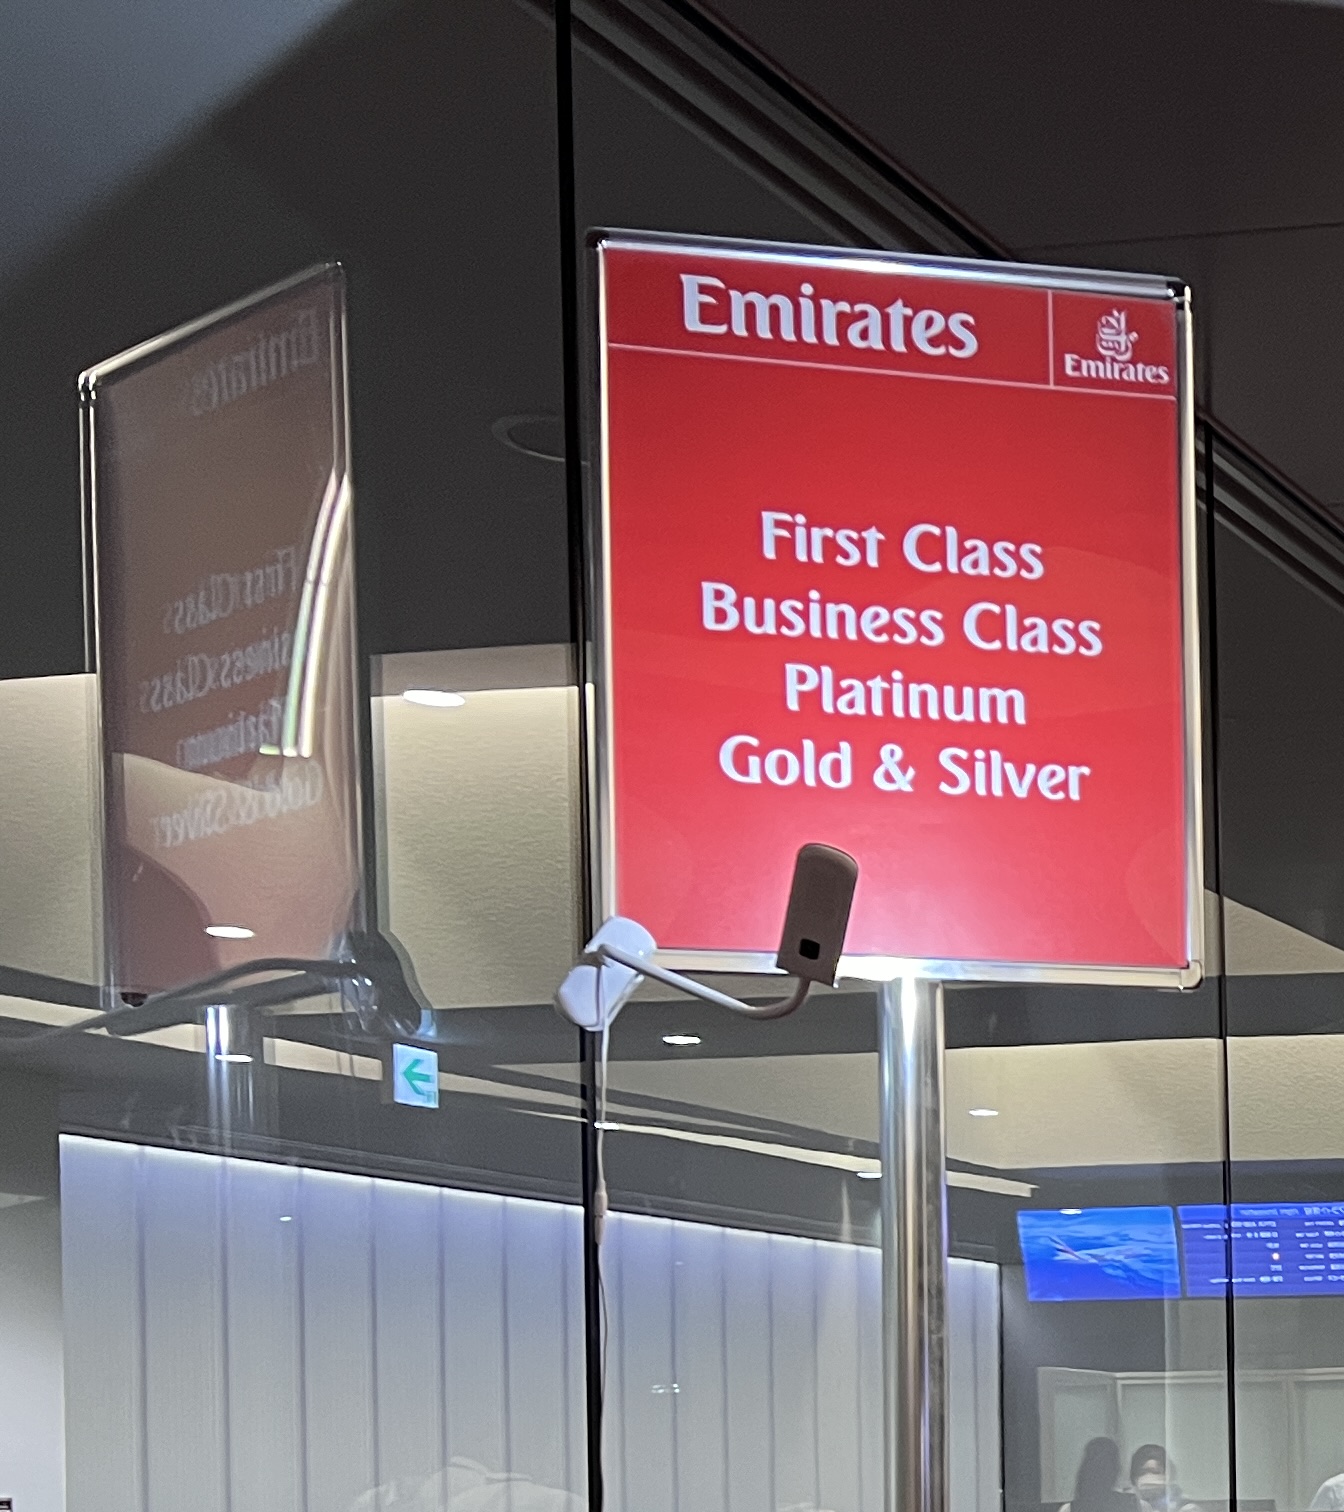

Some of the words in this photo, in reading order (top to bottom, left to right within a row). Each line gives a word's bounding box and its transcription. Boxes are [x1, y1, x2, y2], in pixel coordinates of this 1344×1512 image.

[679, 273, 979, 358] Emirates
[1064, 353, 1169, 384] Emirates
[761, 511, 885, 568] First
[902, 523, 1045, 580] Class
[701, 582, 943, 647] Business
[963, 603, 1103, 656] Class
[785, 663, 1026, 724] Platinum
[719, 735, 852, 788] Gold
[874, 744, 915, 792] &
[939, 747, 1090, 801] Silver
